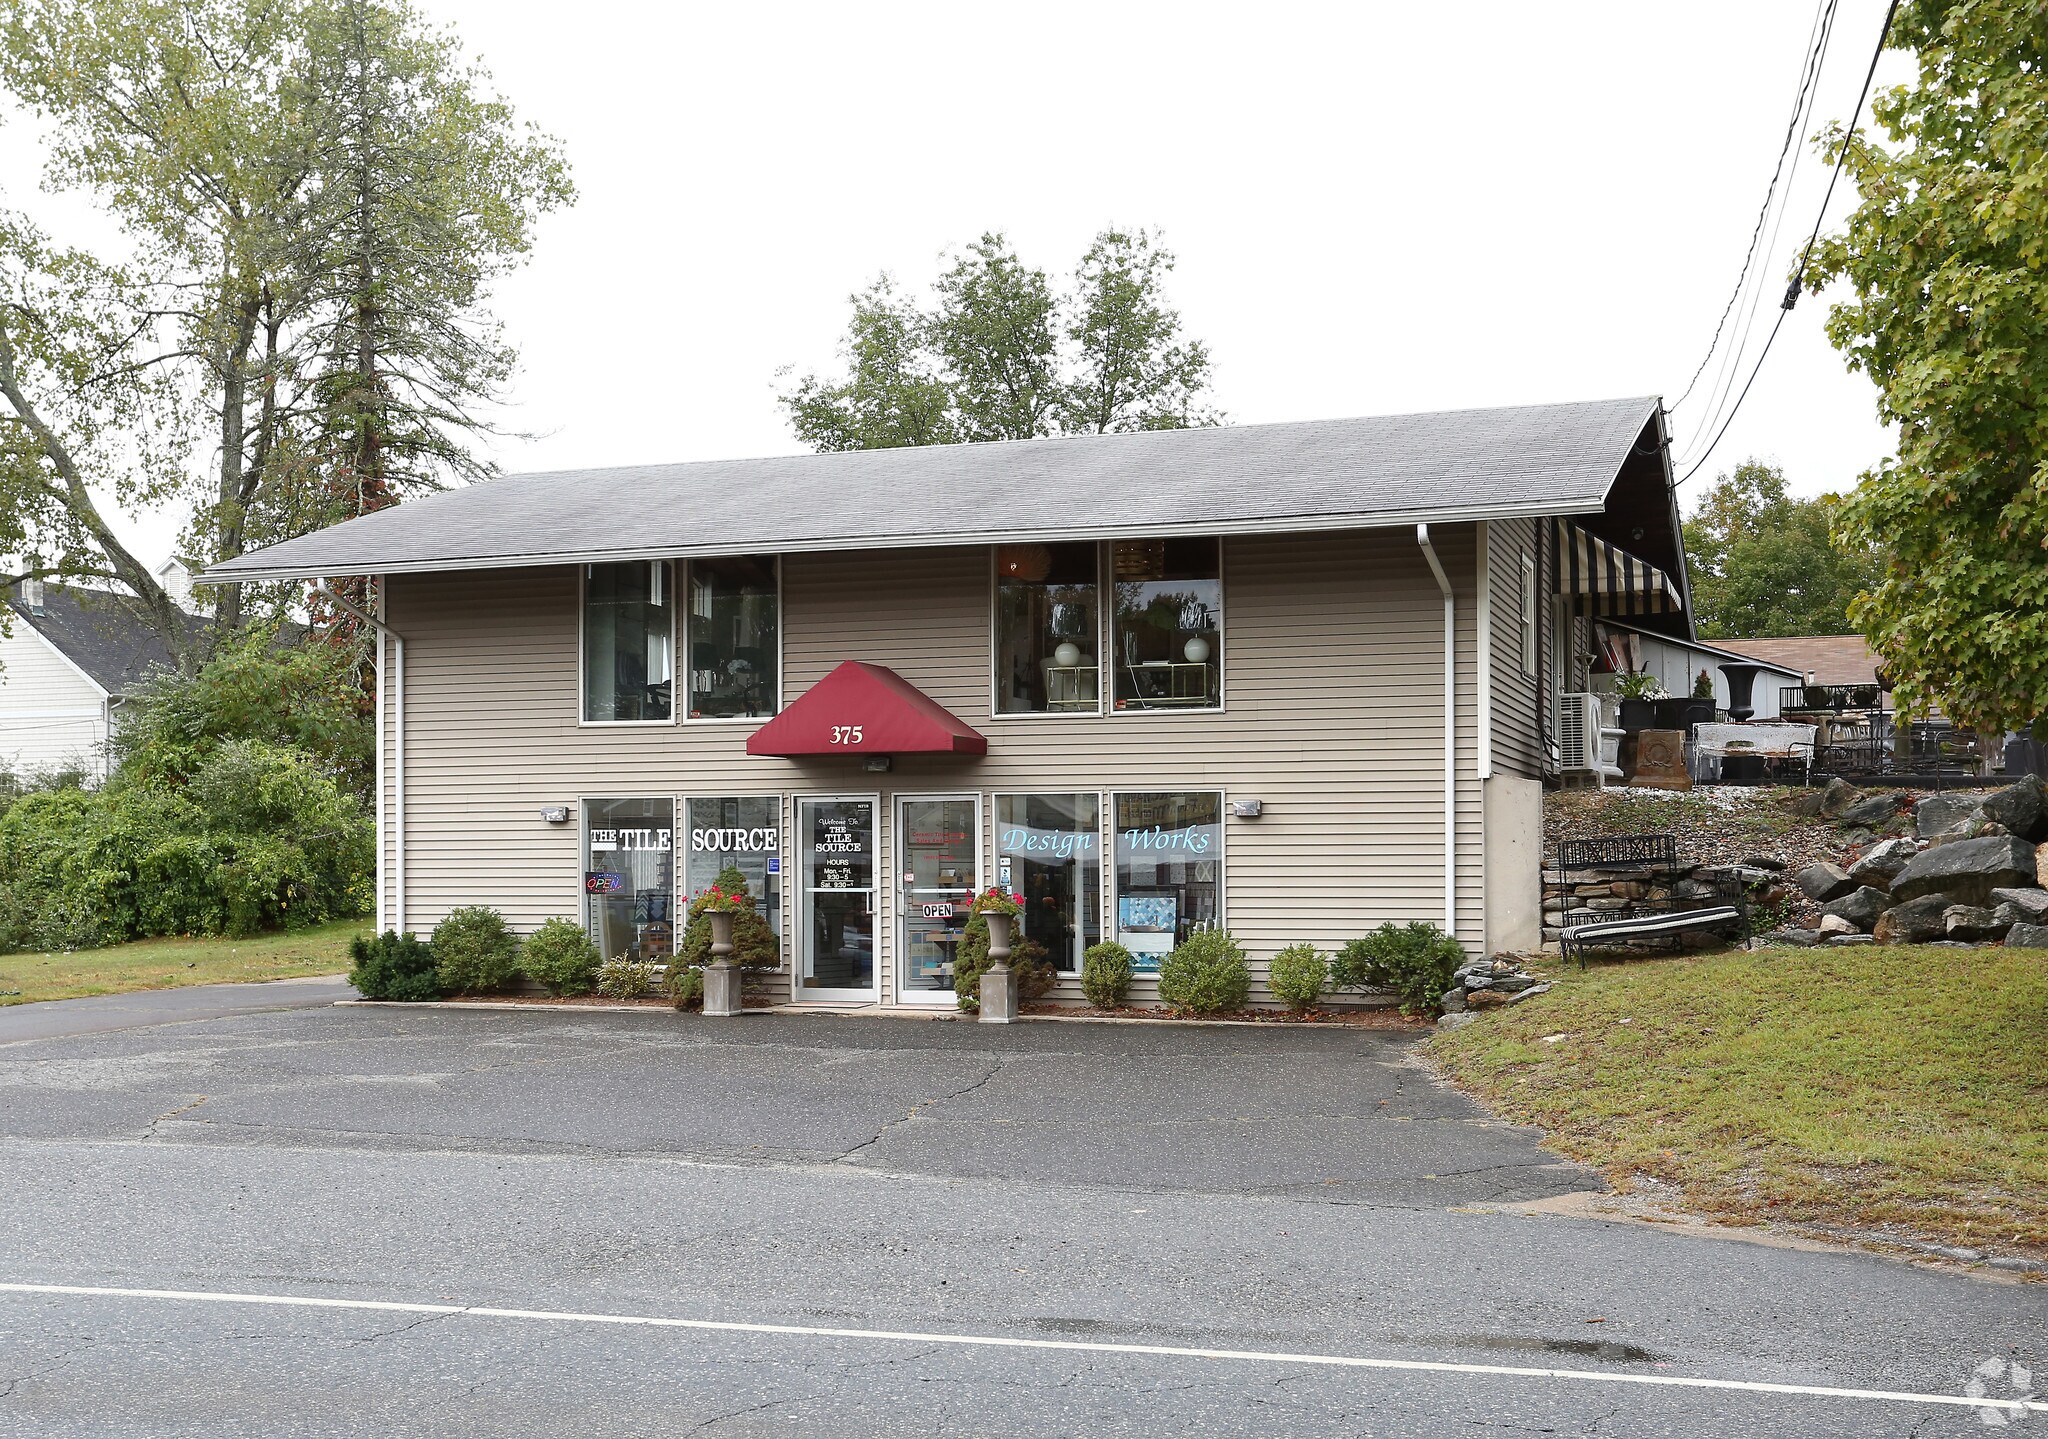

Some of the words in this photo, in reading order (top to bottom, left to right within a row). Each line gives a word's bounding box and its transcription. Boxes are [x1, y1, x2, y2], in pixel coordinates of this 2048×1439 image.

[829, 725, 863, 745] 375
[818, 818, 846, 826] Welcome
[829, 826, 847, 834] THE
[591, 829, 617, 842] THE
[619, 828, 671, 851] TILE
[691, 828, 777, 851] SOURCE
[824, 833, 852, 843] TILE
[1003, 828, 1092, 858] Design
[1124, 825, 1210, 854] Works
[815, 843, 862, 852] SOURCE
[586, 878, 619, 889] OPEN
[924, 904, 952, 917] OPEN
